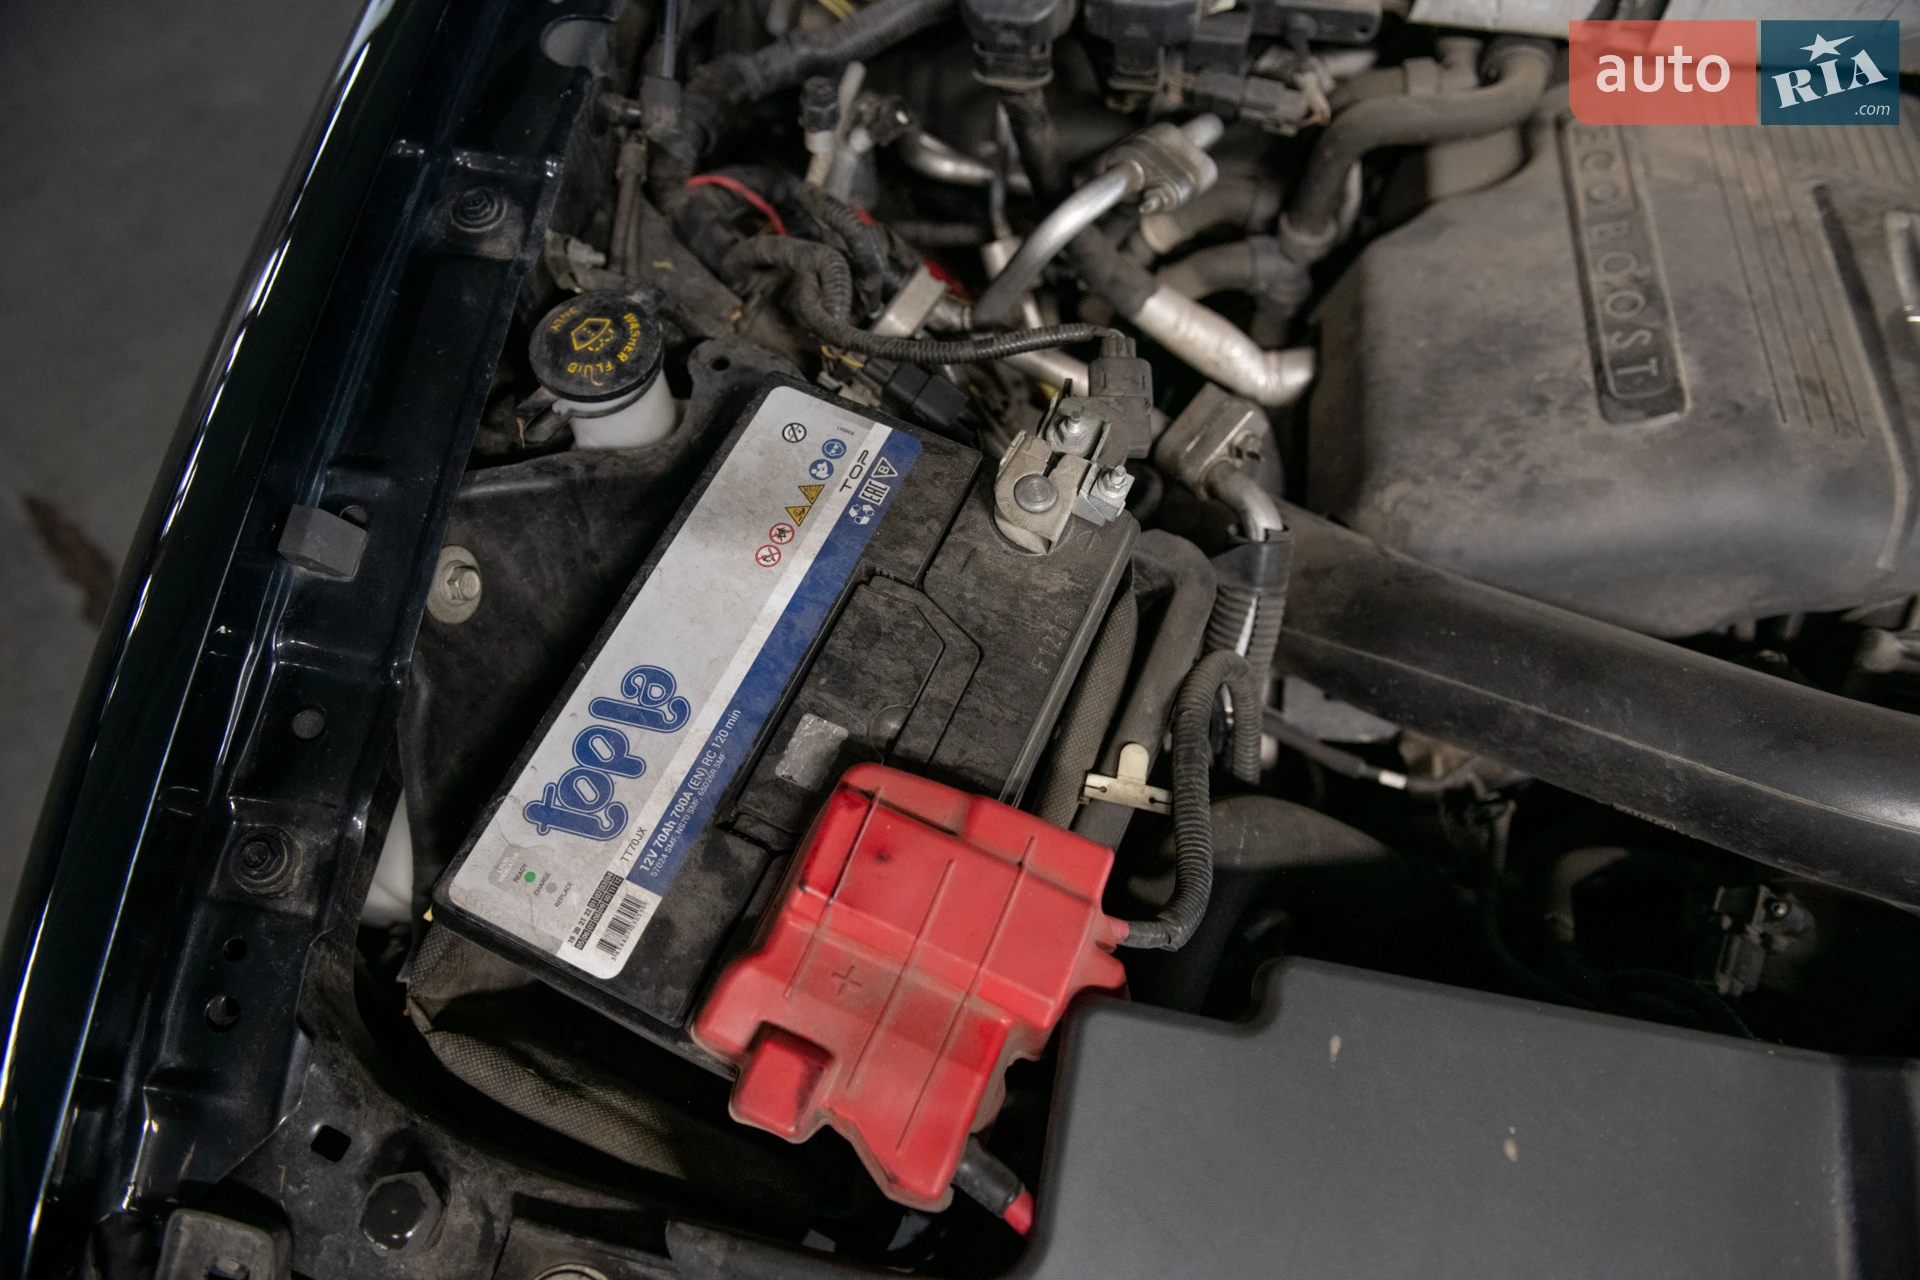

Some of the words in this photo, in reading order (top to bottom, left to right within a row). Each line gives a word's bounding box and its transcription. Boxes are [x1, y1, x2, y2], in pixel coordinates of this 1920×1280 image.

[617, 312, 641, 363] WASHER
[567, 361, 613, 376] FLUID
[839, 449, 869, 492] TOP
[523, 664, 692, 842] topla
[639, 848, 658, 871] 12V
[653, 820, 676, 848] 70Ah
[670, 791, 694, 819] 700A
[687, 767, 709, 790] (EN)
[702, 750, 717, 767] RC
[711, 730, 729, 749] 120
[725, 709, 742, 730] min
[651, 854, 668, 877] 57024
[675, 814, 691, 835] NS70
[714, 753, 726, 768] SMF
[620, 826, 647, 862] TT70JX
[512, 863, 528, 882] READY
[533, 872, 551, 896] CHARGE
[554, 881, 573, 908] REPLACE
